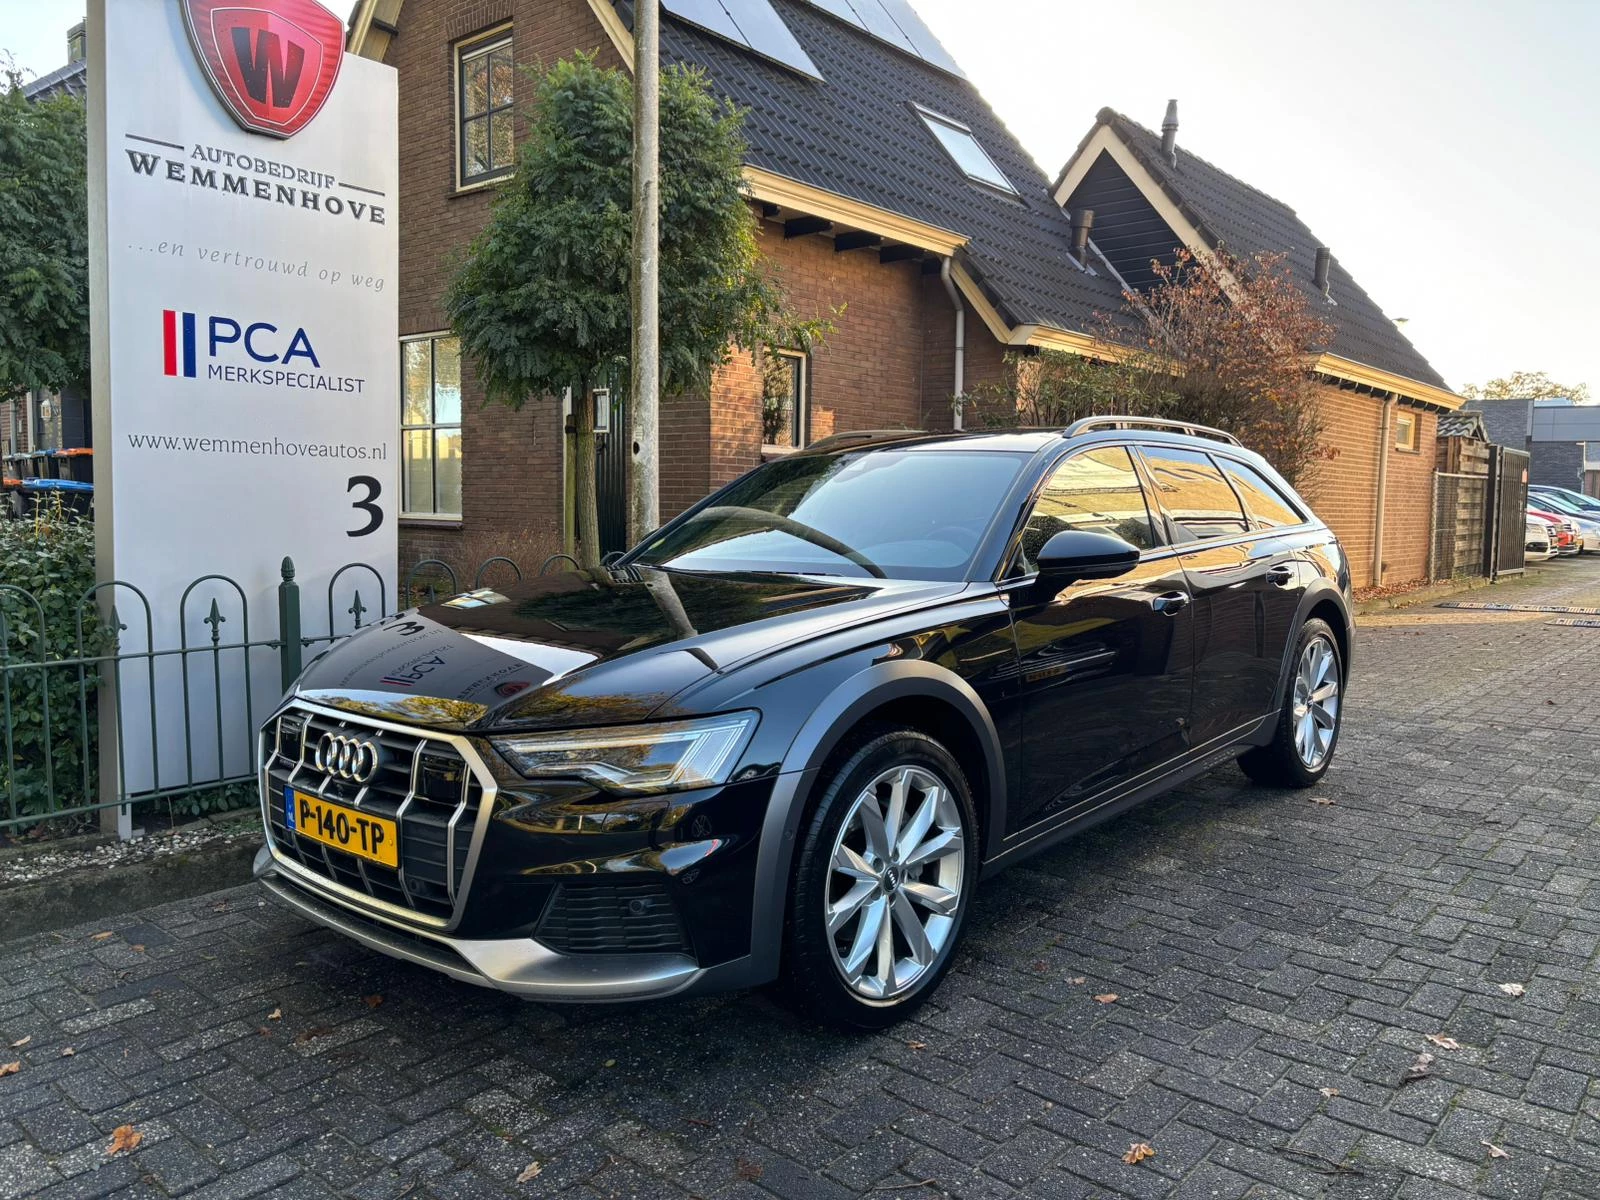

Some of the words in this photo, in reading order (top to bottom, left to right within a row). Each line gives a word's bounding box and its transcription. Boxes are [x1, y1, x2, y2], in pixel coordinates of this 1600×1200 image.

[124, 149, 386, 225] WEMMENHOVE
[191, 144, 336, 190] AUTOBEDRIJF
[198, 247, 308, 278] vertrouwd
[318, 269, 342, 285] op
[351, 275, 385, 292] weg
[208, 315, 321, 368] PCA
[207, 364, 366, 393] MERKSPECIALIST
[127, 434, 388, 460] www.wemmenhoveautos.nl
[345, 475, 385, 538] 3
[299, 800, 385, 855] P-140-TP
